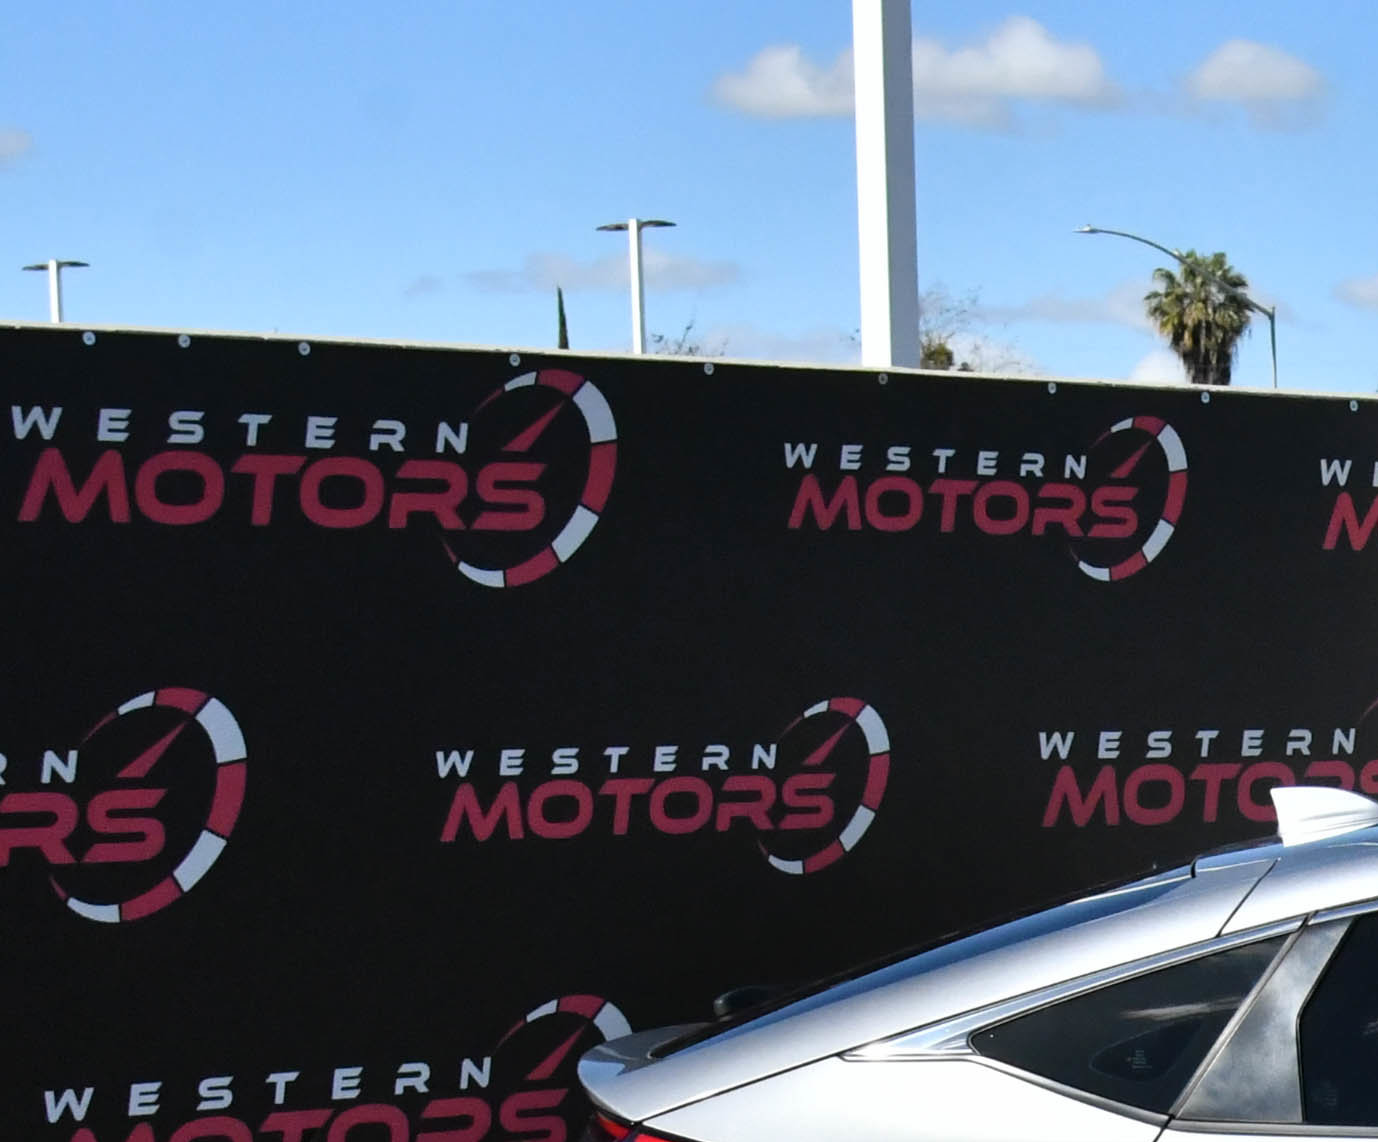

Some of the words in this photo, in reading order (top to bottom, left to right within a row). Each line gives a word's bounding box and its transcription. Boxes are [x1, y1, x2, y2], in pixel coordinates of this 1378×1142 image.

[11, 405, 469, 455] WESTERN
[19, 446, 546, 531] MOTORS
[784, 442, 1088, 480] WESTERN
[788, 475, 1138, 538] MOTORS
[435, 743, 777, 779] WESTERN
[1038, 727, 1356, 761] WESTERN
[441, 773, 834, 842] MOTORS
[44, 1056, 492, 1124] WESTERN
